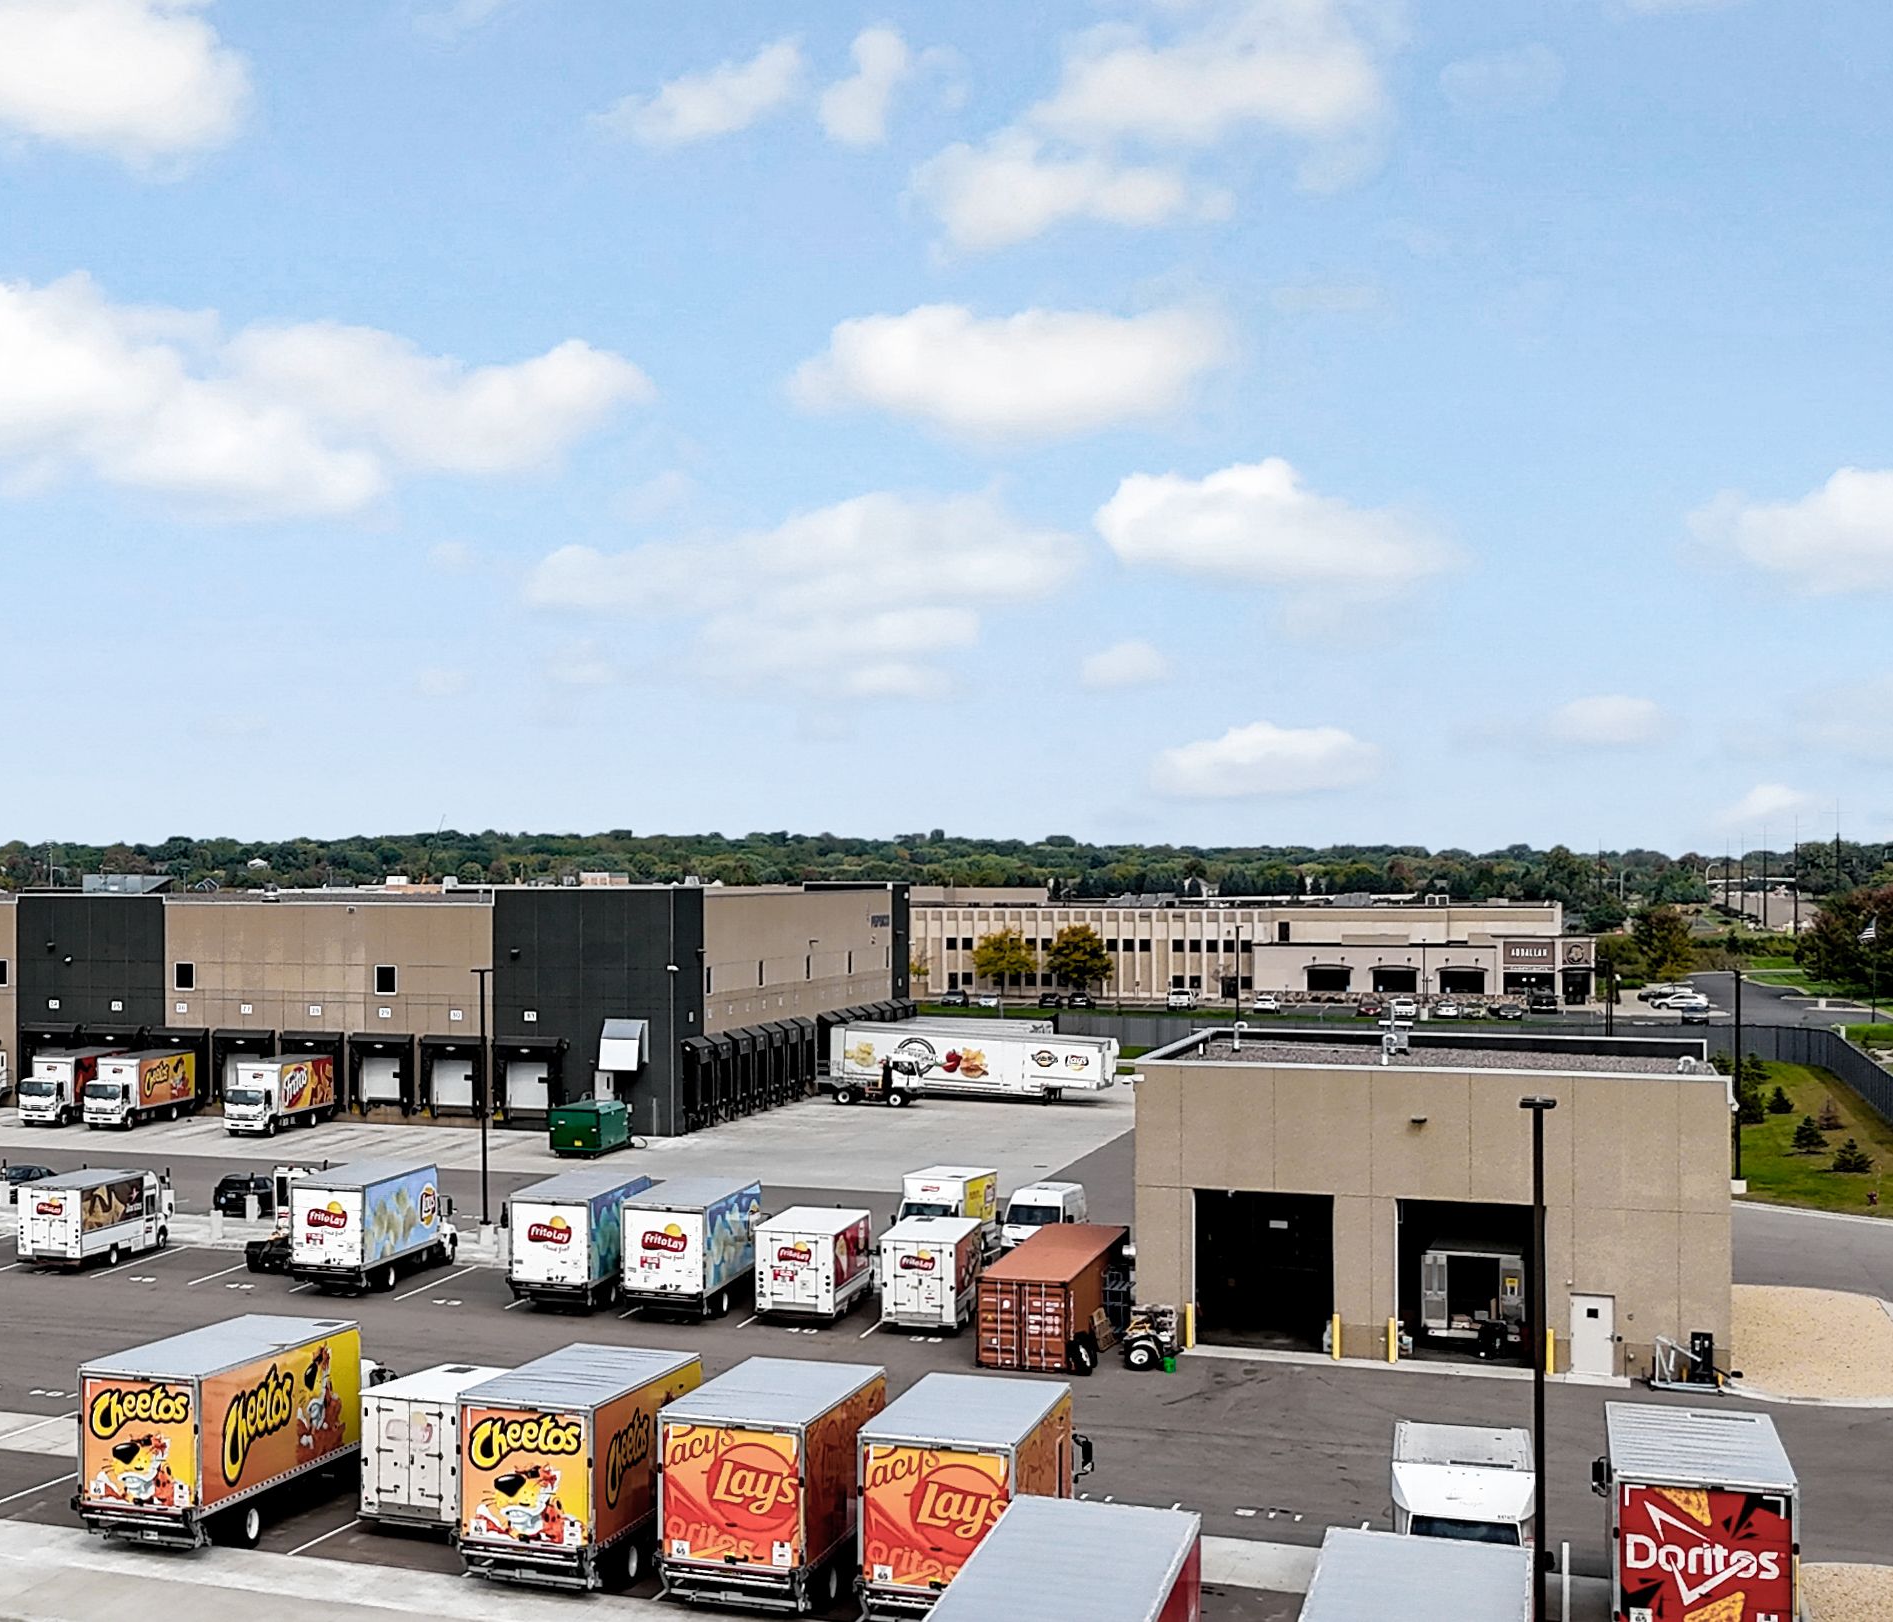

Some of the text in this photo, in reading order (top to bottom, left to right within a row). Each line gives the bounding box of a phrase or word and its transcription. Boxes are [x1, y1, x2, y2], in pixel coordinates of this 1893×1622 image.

[284, 1065, 307, 1106] Fritos
[91, 1384, 189, 1438] Cheetos
[223, 1366, 293, 1485] Cheetos
[470, 1414, 582, 1469] Cheetos
[607, 1409, 649, 1508] Cheetos
[713, 1460, 799, 1515] Lay's
[916, 1482, 1008, 1538] Lay's
[1625, 1532, 1782, 1606] Doritos
